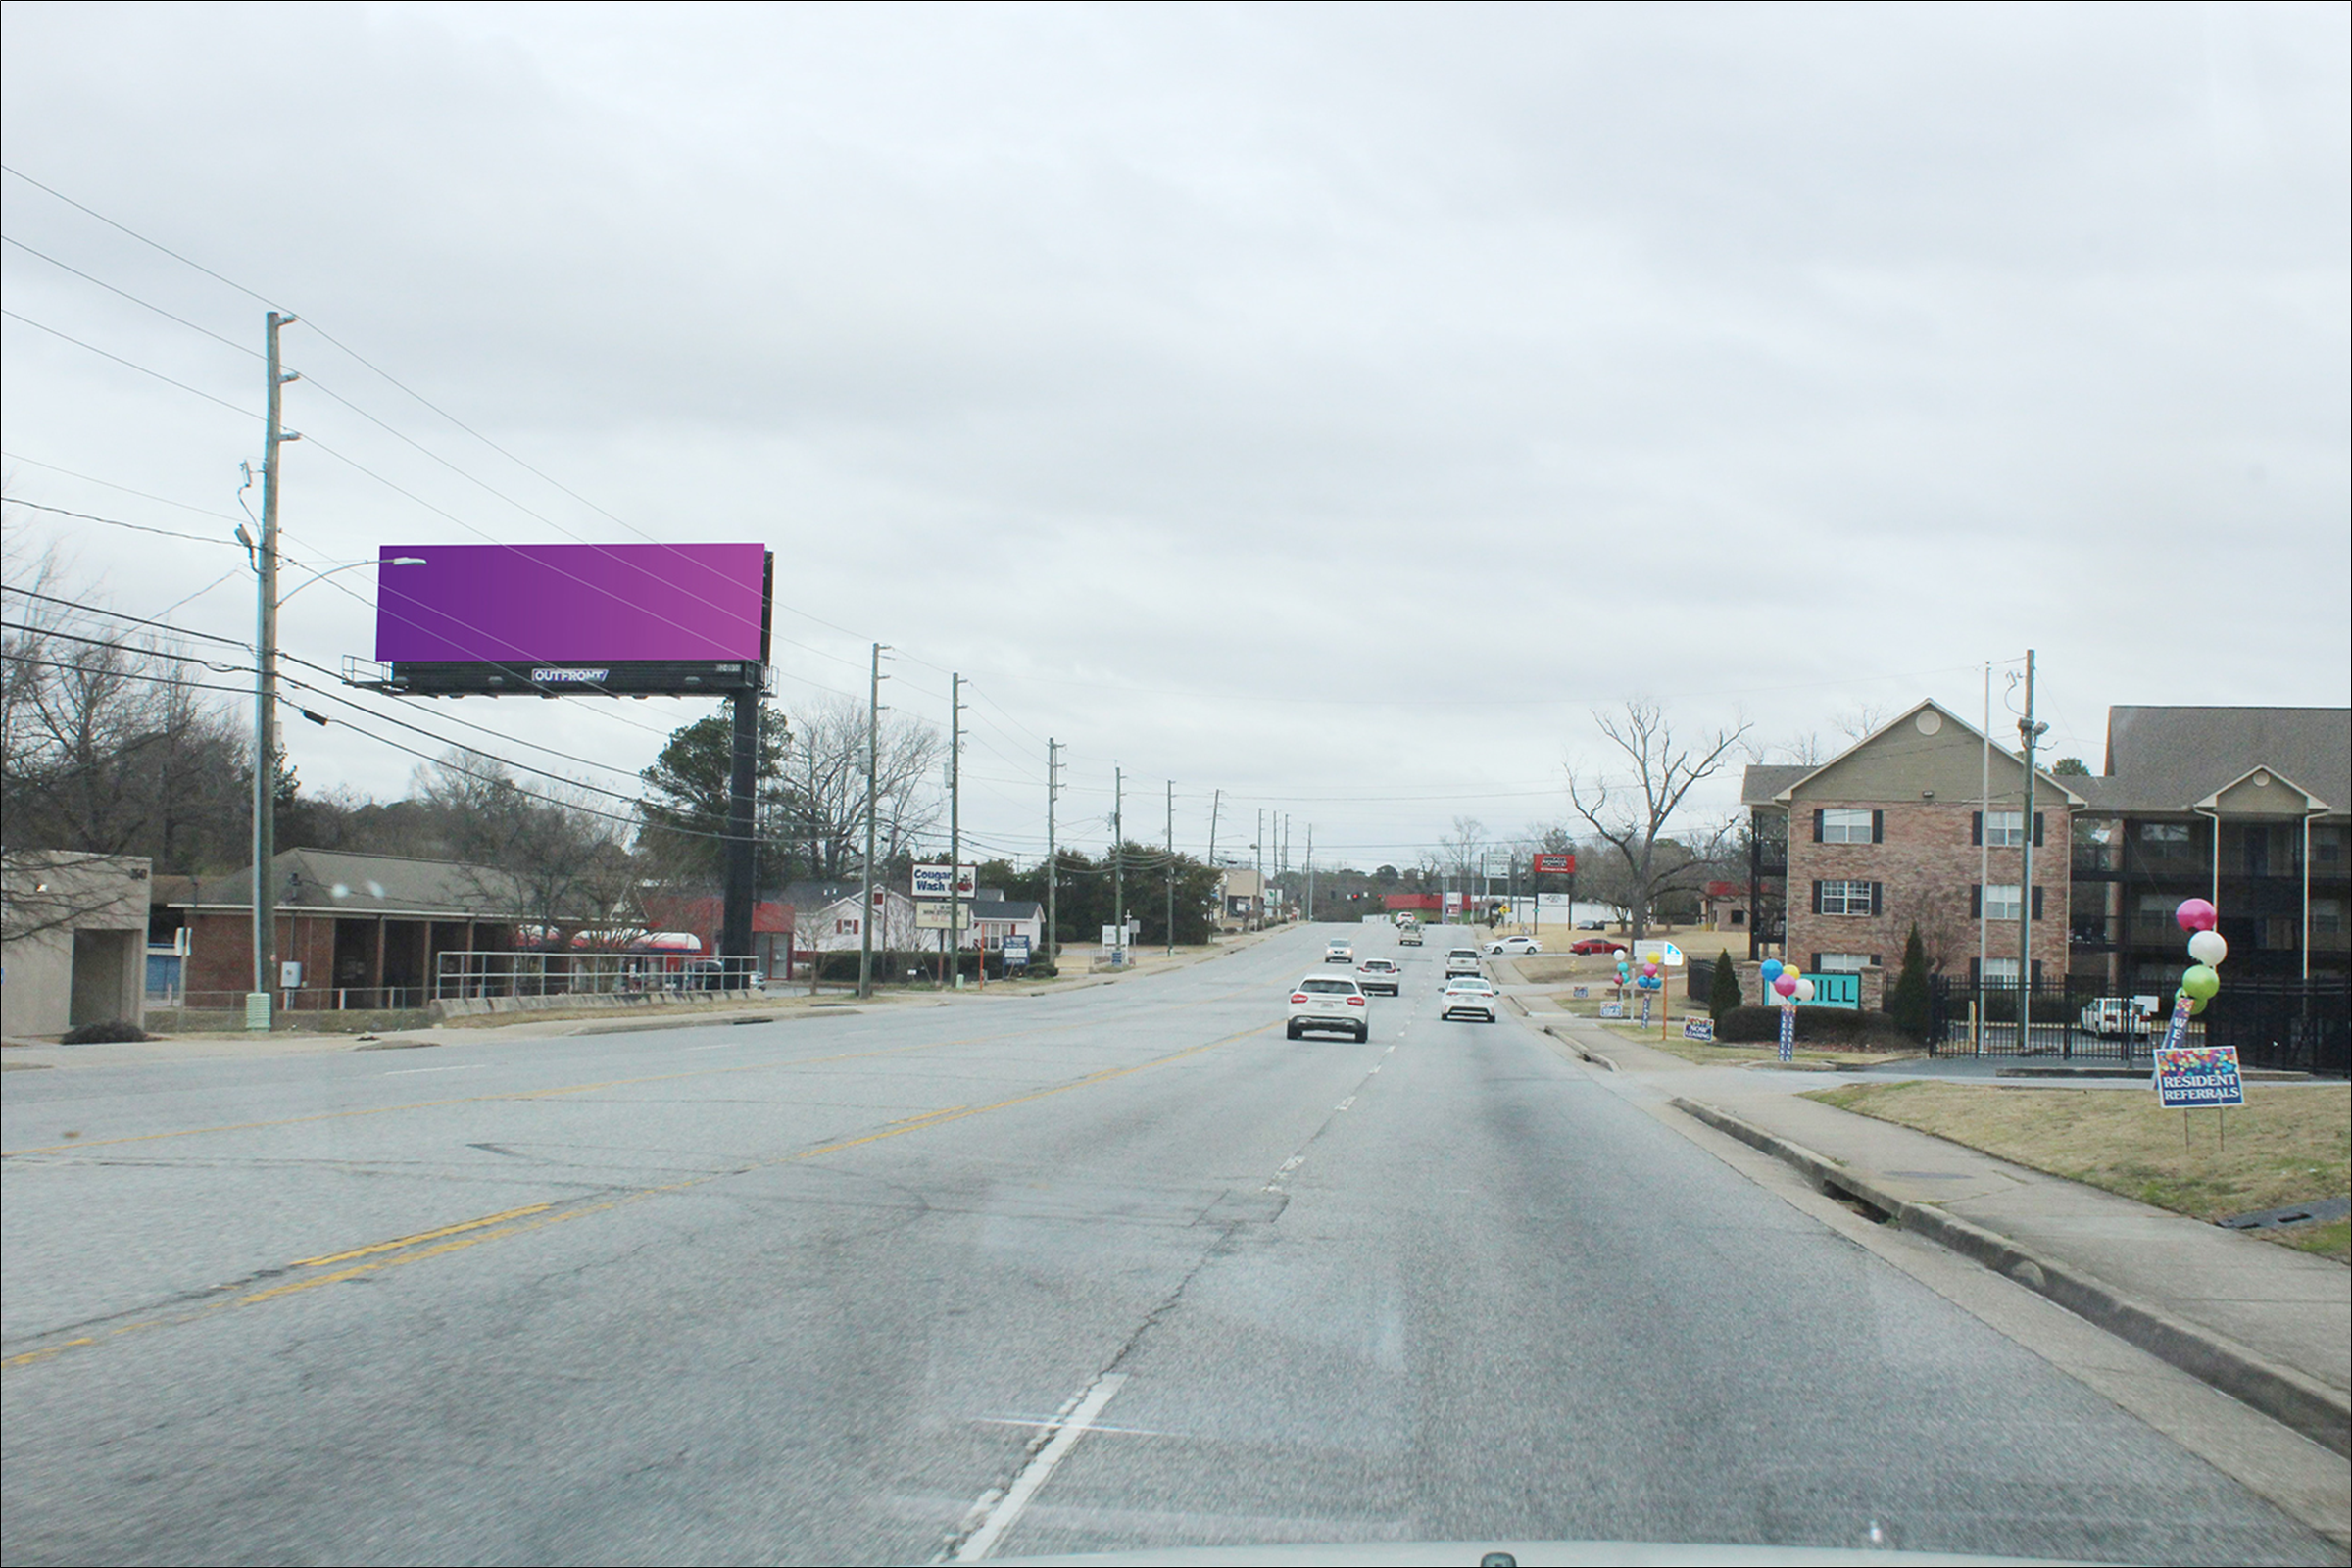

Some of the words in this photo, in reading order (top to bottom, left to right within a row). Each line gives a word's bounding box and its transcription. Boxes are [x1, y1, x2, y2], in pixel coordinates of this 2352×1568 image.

[914, 869, 952, 881] Cougar
[916, 880, 946, 891] Wash
[2163, 1073, 2237, 1088] RESIDENT
[2164, 1087, 2240, 1100] REFERRALS
